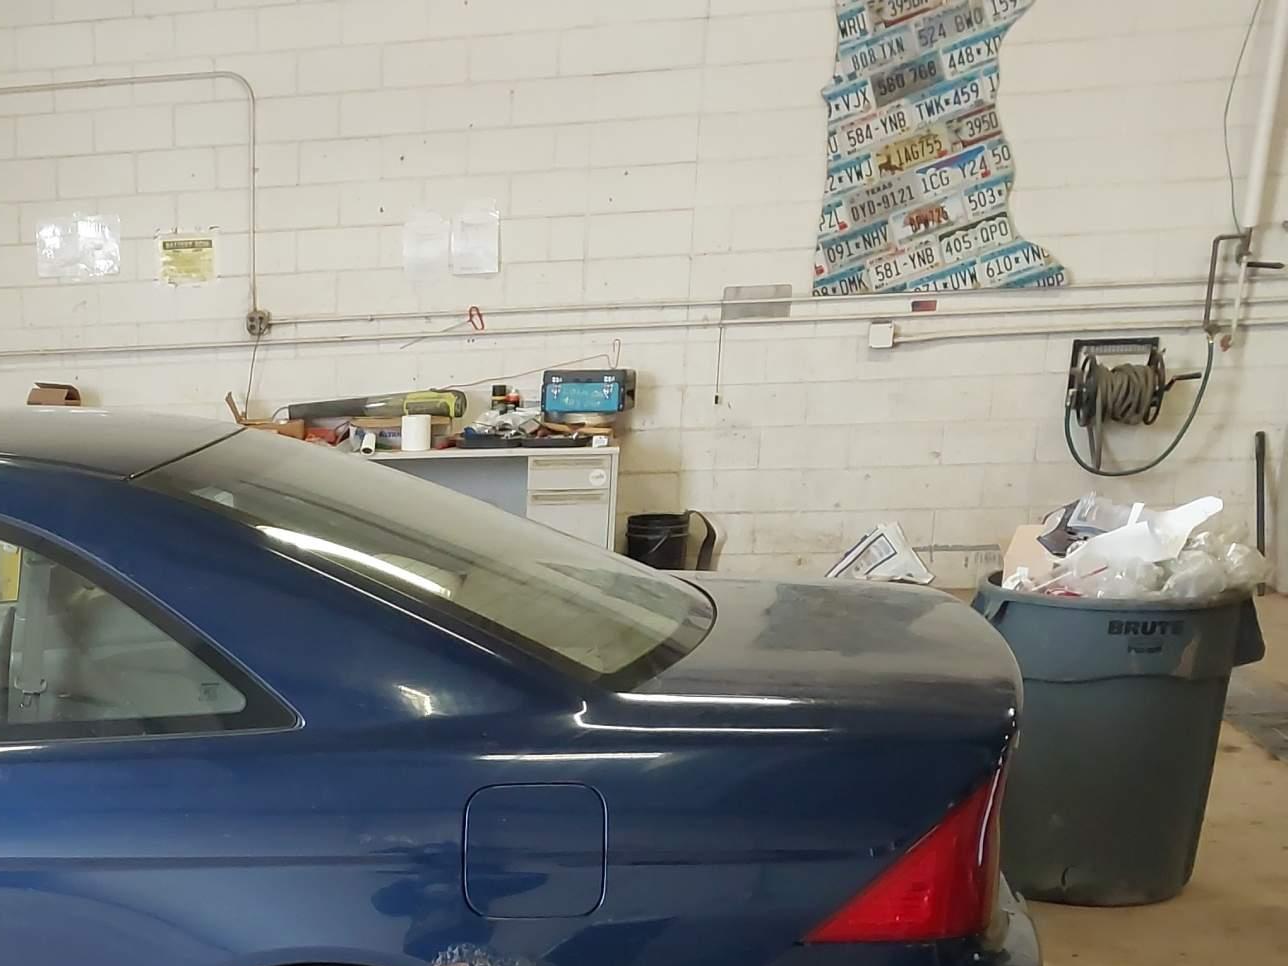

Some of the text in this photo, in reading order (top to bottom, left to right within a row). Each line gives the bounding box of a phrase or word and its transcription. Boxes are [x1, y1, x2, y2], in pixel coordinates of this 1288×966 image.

[948, 46, 975, 70] 448
[915, 82, 980, 121] TWK 459
[846, 111, 907, 148] 584-YNB
[844, 160, 873, 185] VWJ
[827, 239, 853, 264] 091
[874, 247, 935, 283] 581-YNB
[986, 255, 1013, 279] 610
[1108, 619, 1185, 636] BRUTE
